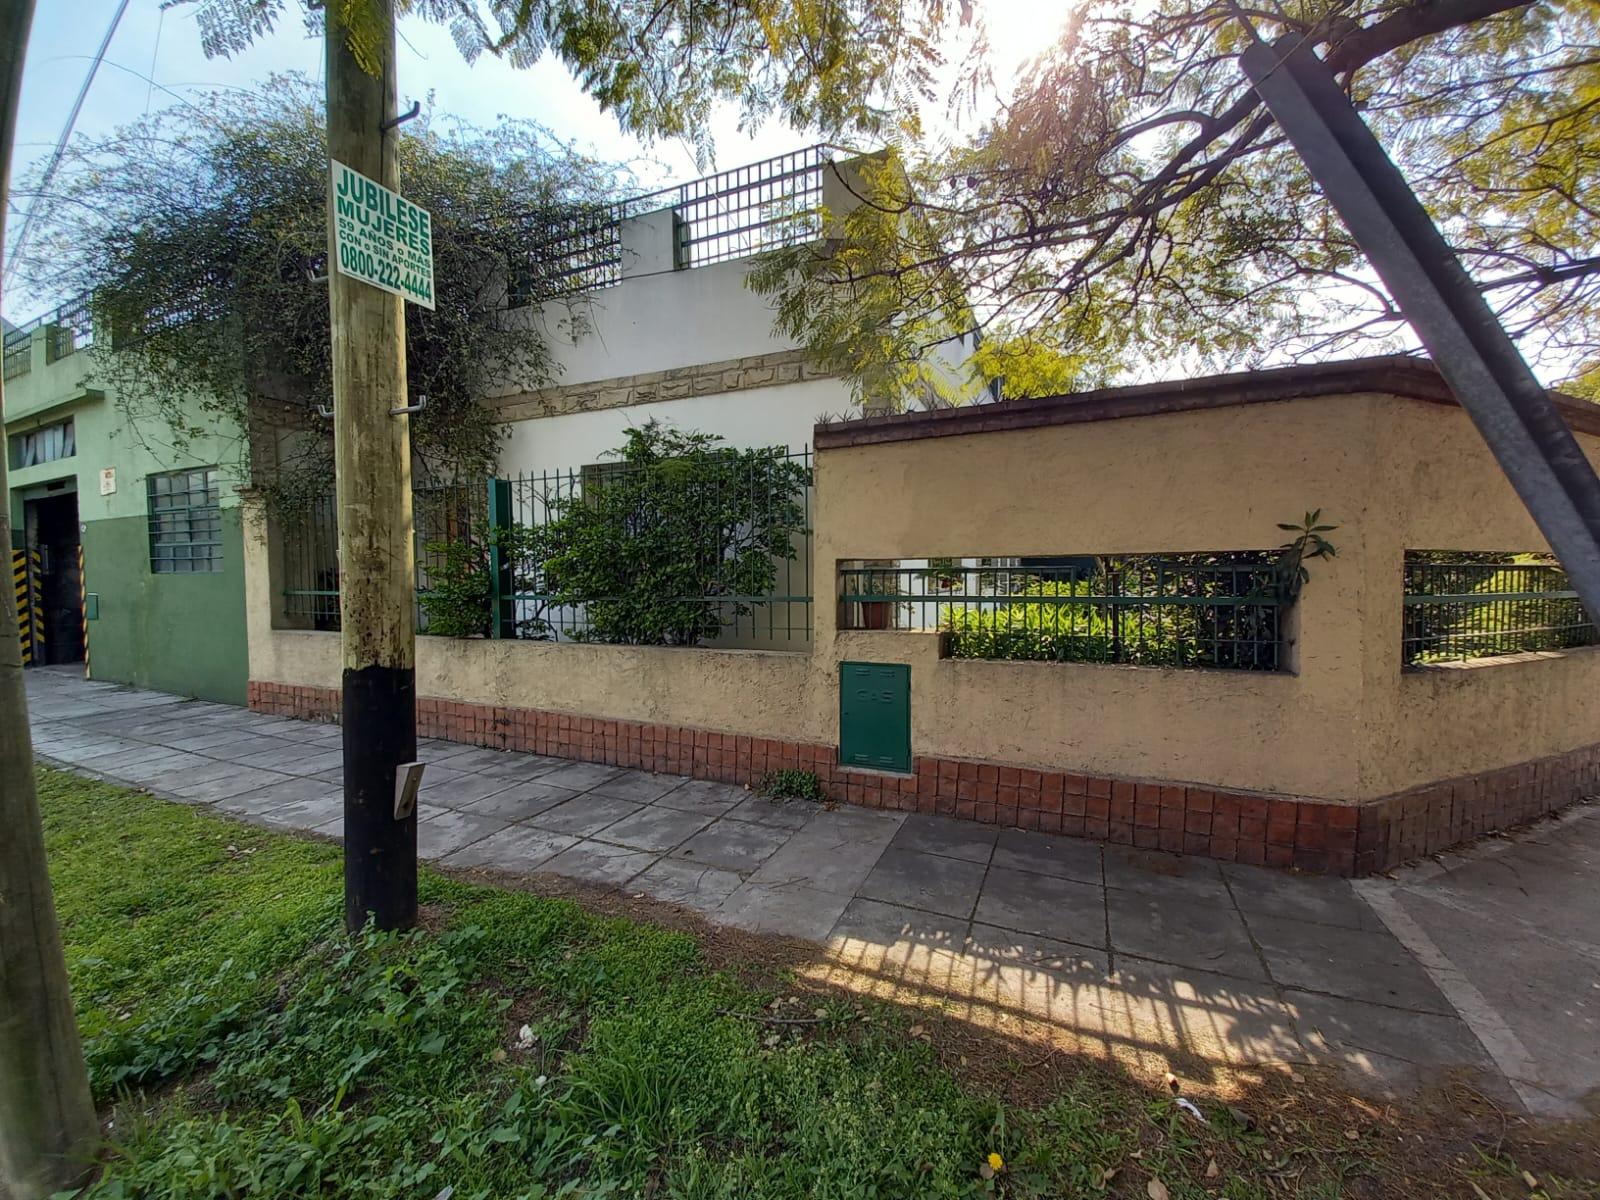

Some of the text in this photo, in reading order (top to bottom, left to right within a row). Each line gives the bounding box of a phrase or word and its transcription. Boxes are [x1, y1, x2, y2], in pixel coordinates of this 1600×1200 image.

[337, 169, 429, 239] JUBILESE
[338, 196, 430, 256] MUJERES
[339, 218, 354, 232] 59
[359, 226, 394, 250] AÑOS
[339, 230, 361, 247] CON
[373, 246, 389, 259] SIN
[392, 254, 431, 278] APORTES
[341, 243, 431, 303] 0800-222-4444
